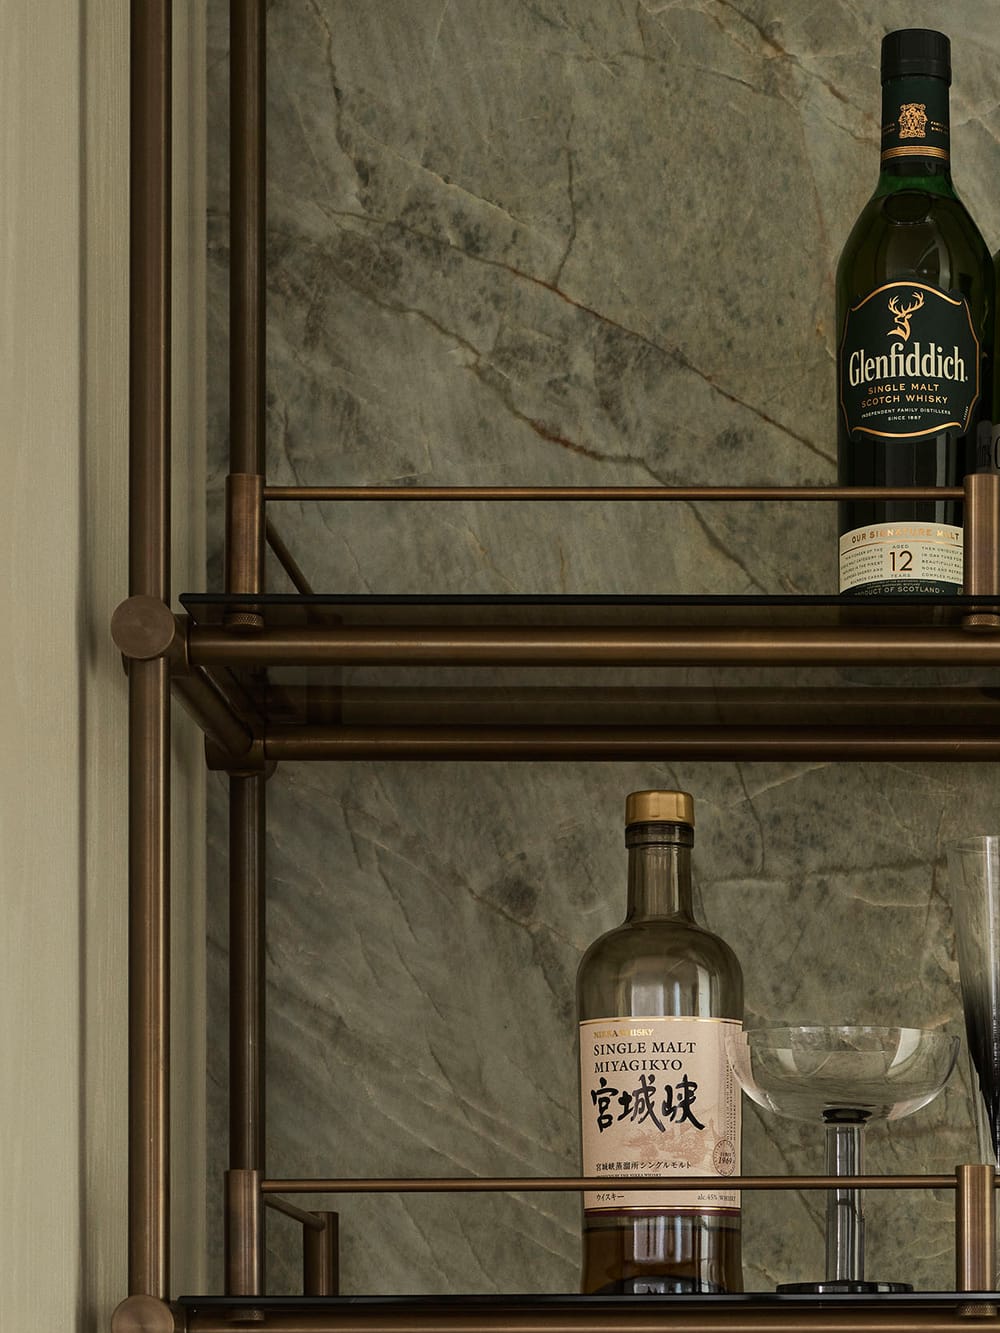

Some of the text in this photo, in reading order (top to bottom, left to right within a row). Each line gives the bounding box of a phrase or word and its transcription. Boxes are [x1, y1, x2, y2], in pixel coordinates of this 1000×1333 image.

[849, 342, 966, 387] Glenfiddich
[867, 383, 940, 395] SINGLE MALT
[861, 395, 949, 408] SCOTCH WHISKY
[861, 408, 896, 419] INDEPENDENT
[920, 408, 952, 416] DISTILLERS
[851, 527, 960, 543] OUR SIGNATURE MALT
[889, 550, 913, 572] 12
[897, 585, 940, 594] SCOTLAND
[593, 1029, 619, 1039] NIKKA
[593, 1042, 697, 1057] SINGLE MALT
[594, 1059, 683, 1073] MIYAGIKYO
[591, 1073, 706, 1133] 宮城峡
